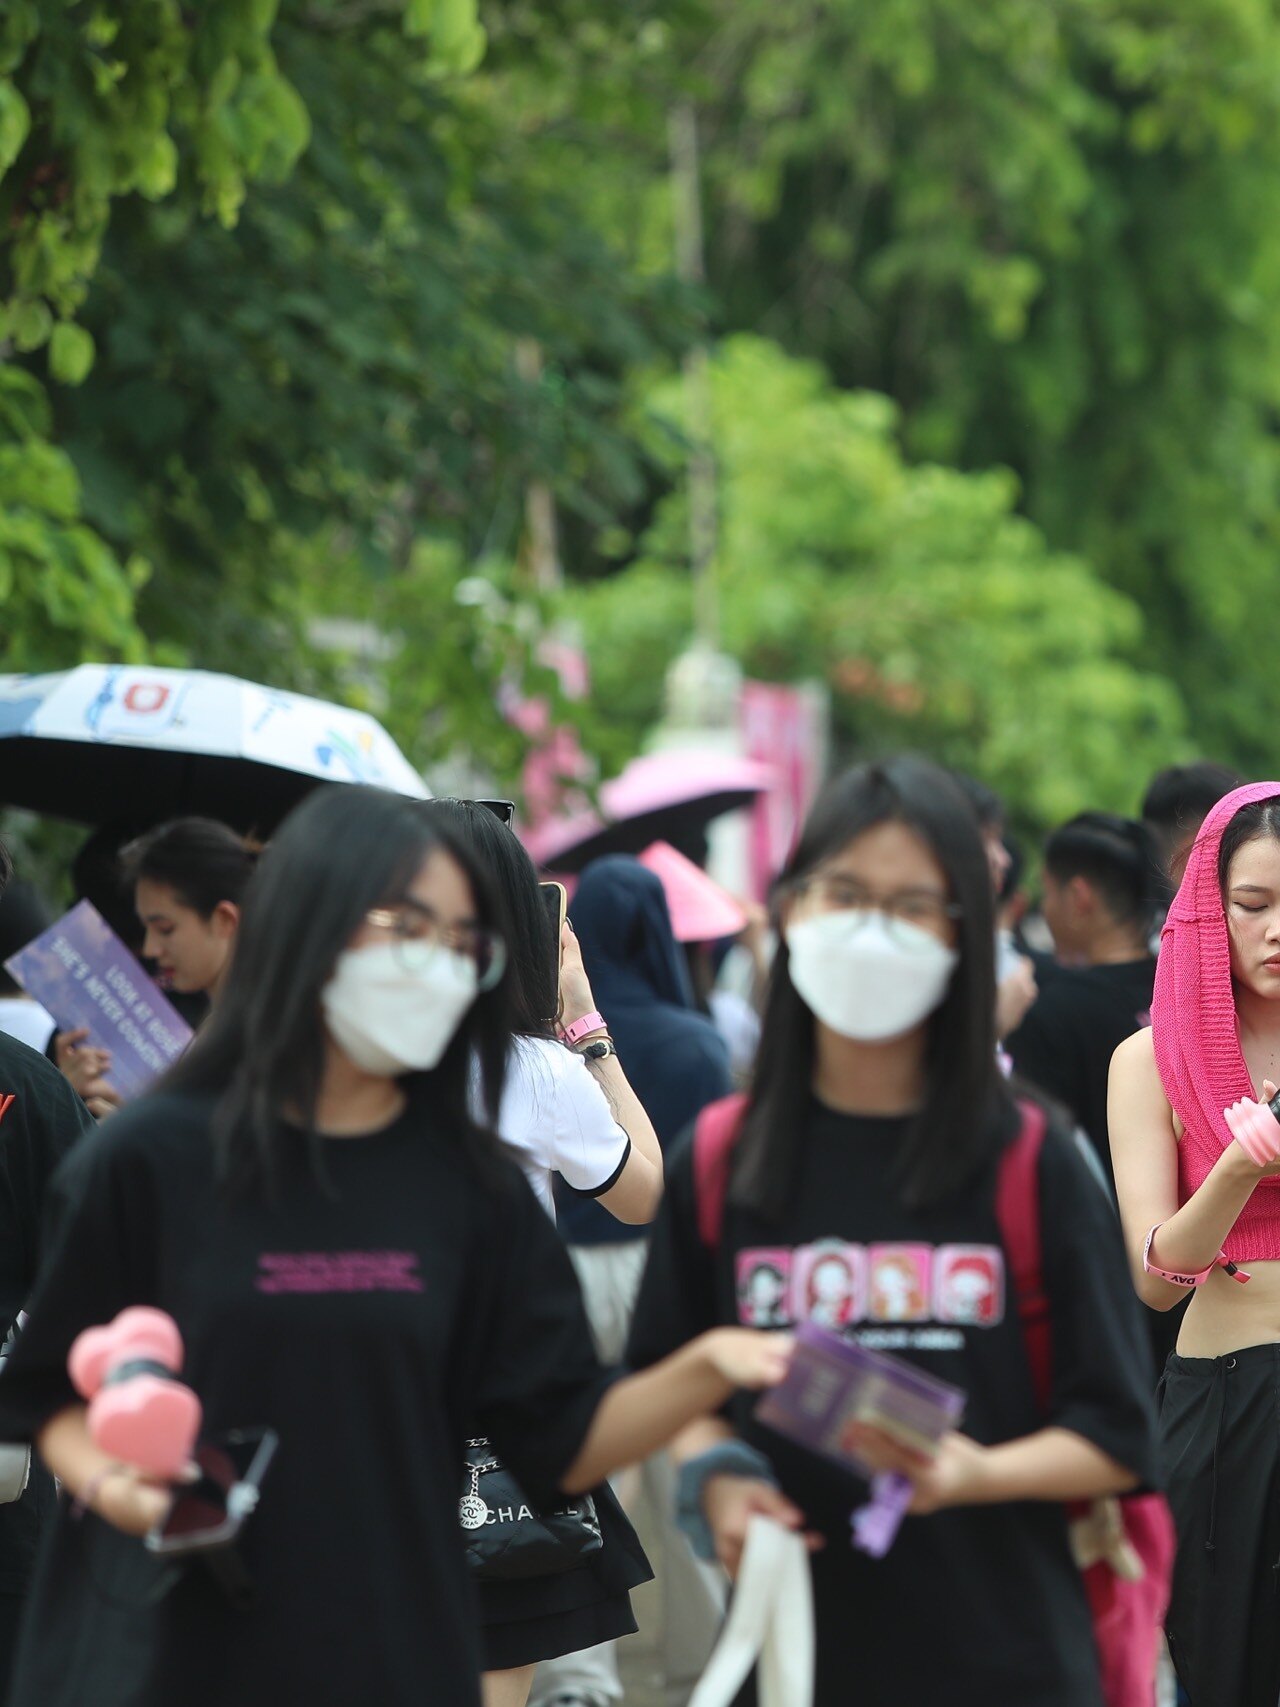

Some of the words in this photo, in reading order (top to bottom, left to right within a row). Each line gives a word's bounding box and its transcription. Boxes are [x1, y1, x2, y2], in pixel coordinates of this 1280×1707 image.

[51, 935, 90, 980] SHE'S
[83, 975, 125, 1022] NEVER
[105, 964, 139, 1004] LOOK
[132, 1001, 153, 1023] AT
[1170, 1275, 1196, 1285] DAY
